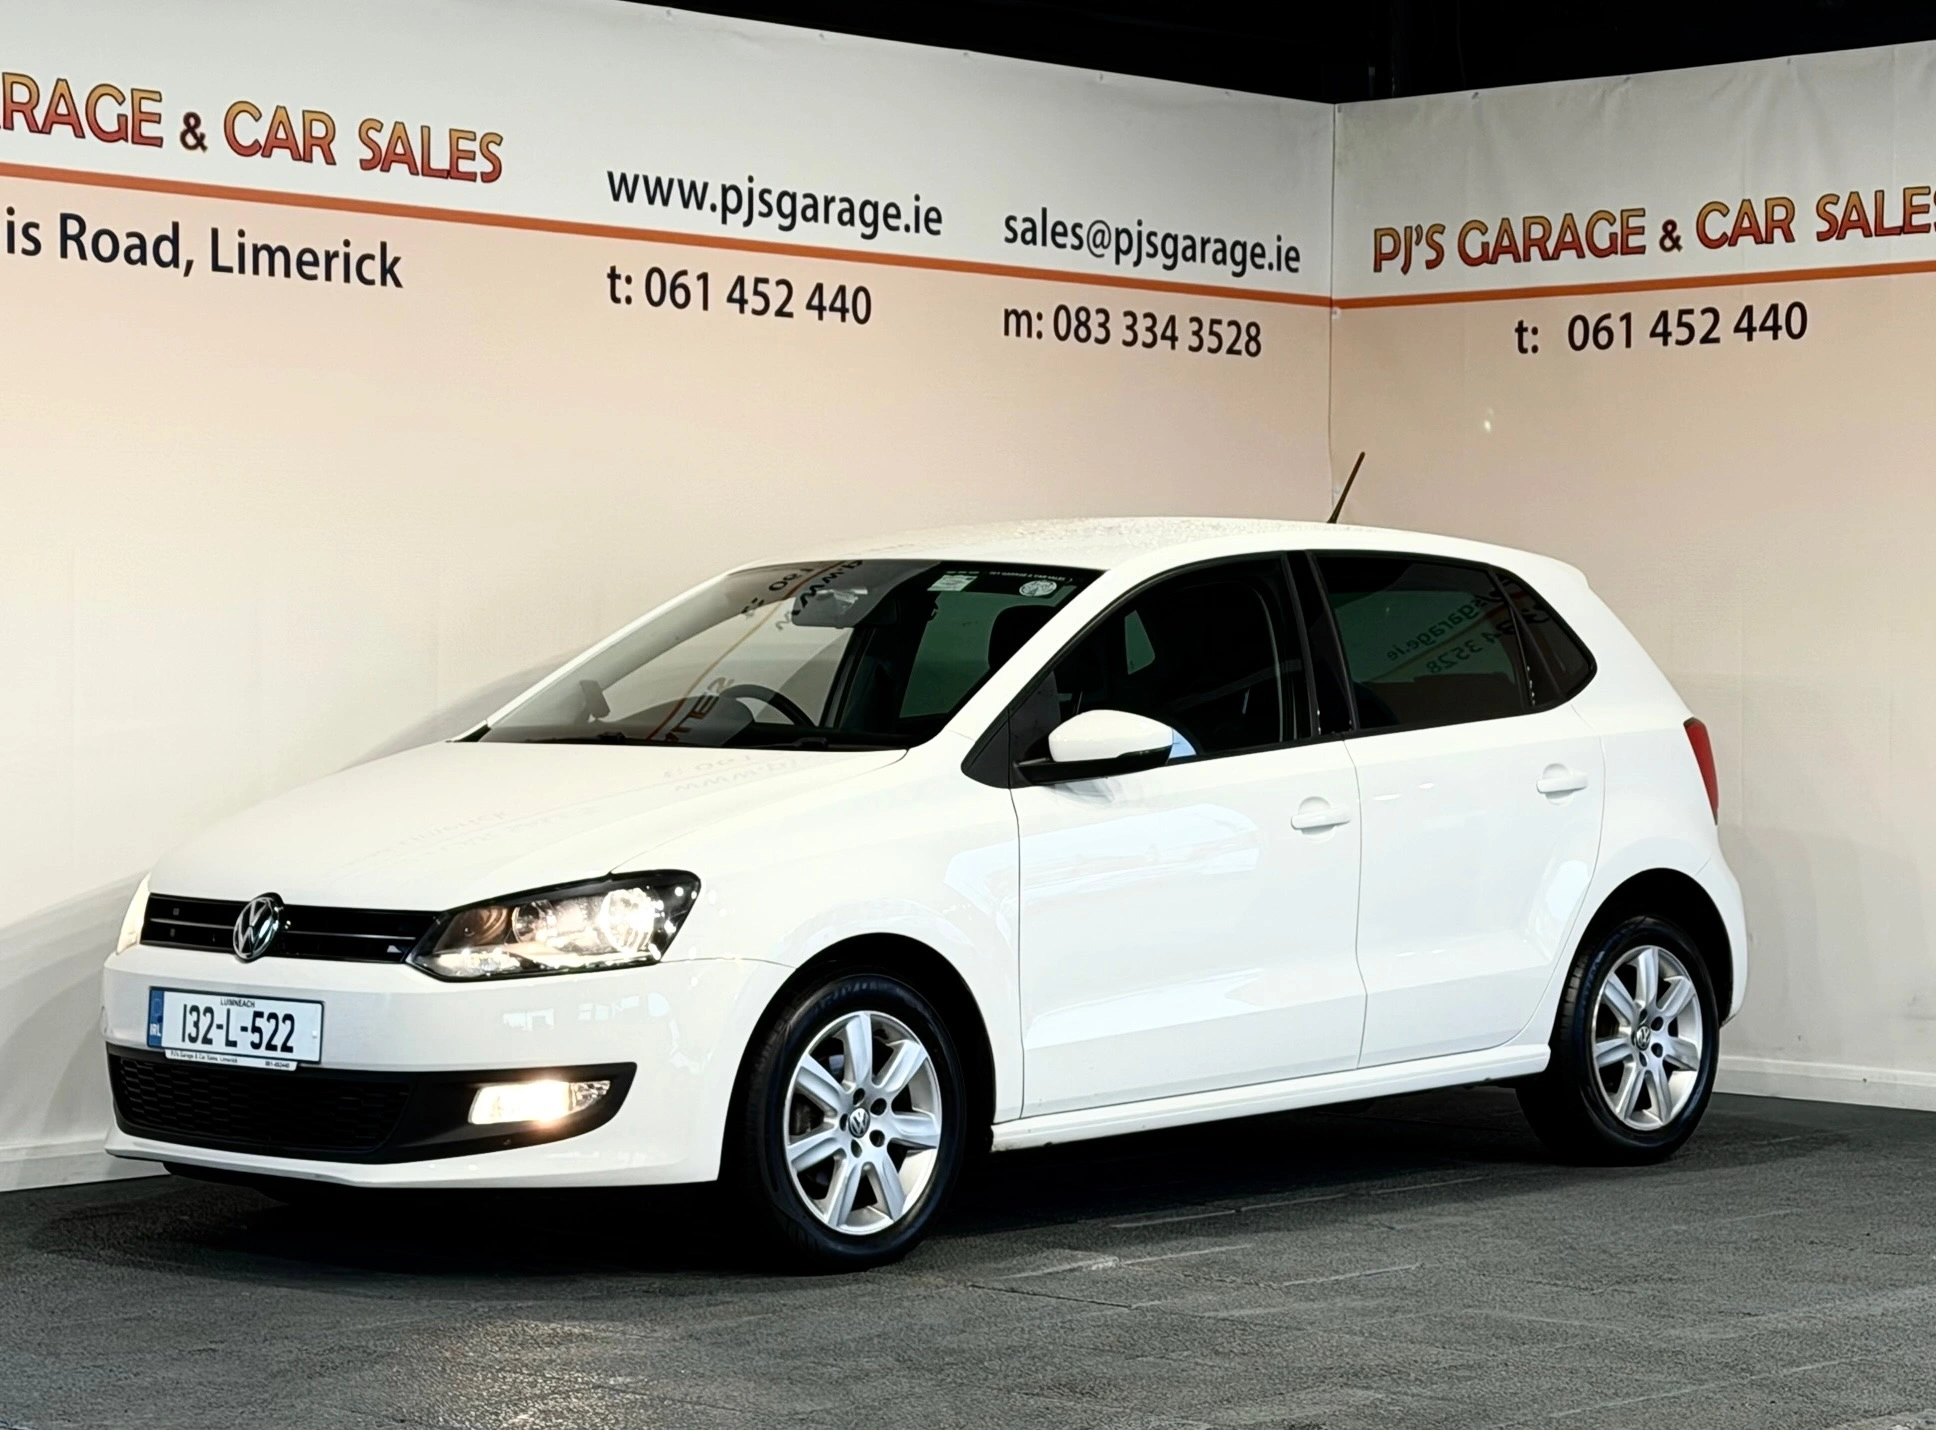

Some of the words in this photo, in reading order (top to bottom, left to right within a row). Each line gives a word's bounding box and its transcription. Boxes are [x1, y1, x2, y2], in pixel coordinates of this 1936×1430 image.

[0, 72, 163, 148] RAGE
[180, 111, 208, 153] &
[224, 100, 336, 166] CAR
[359, 118, 504, 184] SALES
[607, 170, 943, 240] www.pjsgarage.ie
[1373, 222, 1446, 275] PJ'S
[1457, 208, 1646, 268] GARAGE
[1659, 219, 1683, 253] &
[1696, 196, 1796, 250] CAR
[1815, 186, 1936, 242] SALE
[59, 212, 194, 278] Road,
[210, 227, 404, 288] Limerick
[1004, 207, 1301, 278] sales@pjsgarage.ie
[607, 265, 633, 305] t:
[645, 266, 710, 312] 061
[726, 275, 795, 319] 452
[805, 282, 872, 325] 440
[1515, 319, 1539, 354] t:
[1568, 312, 1633, 352] 061
[1649, 307, 1721, 347] 452
[1733, 301, 1808, 342] 440
[1003, 306, 1043, 340] m:
[1053, 304, 1111, 345] 083
[1121, 310, 1179, 350] 334
[1188, 317, 1262, 358] 3528
[181, 1003, 295, 1053] 132-L-522
